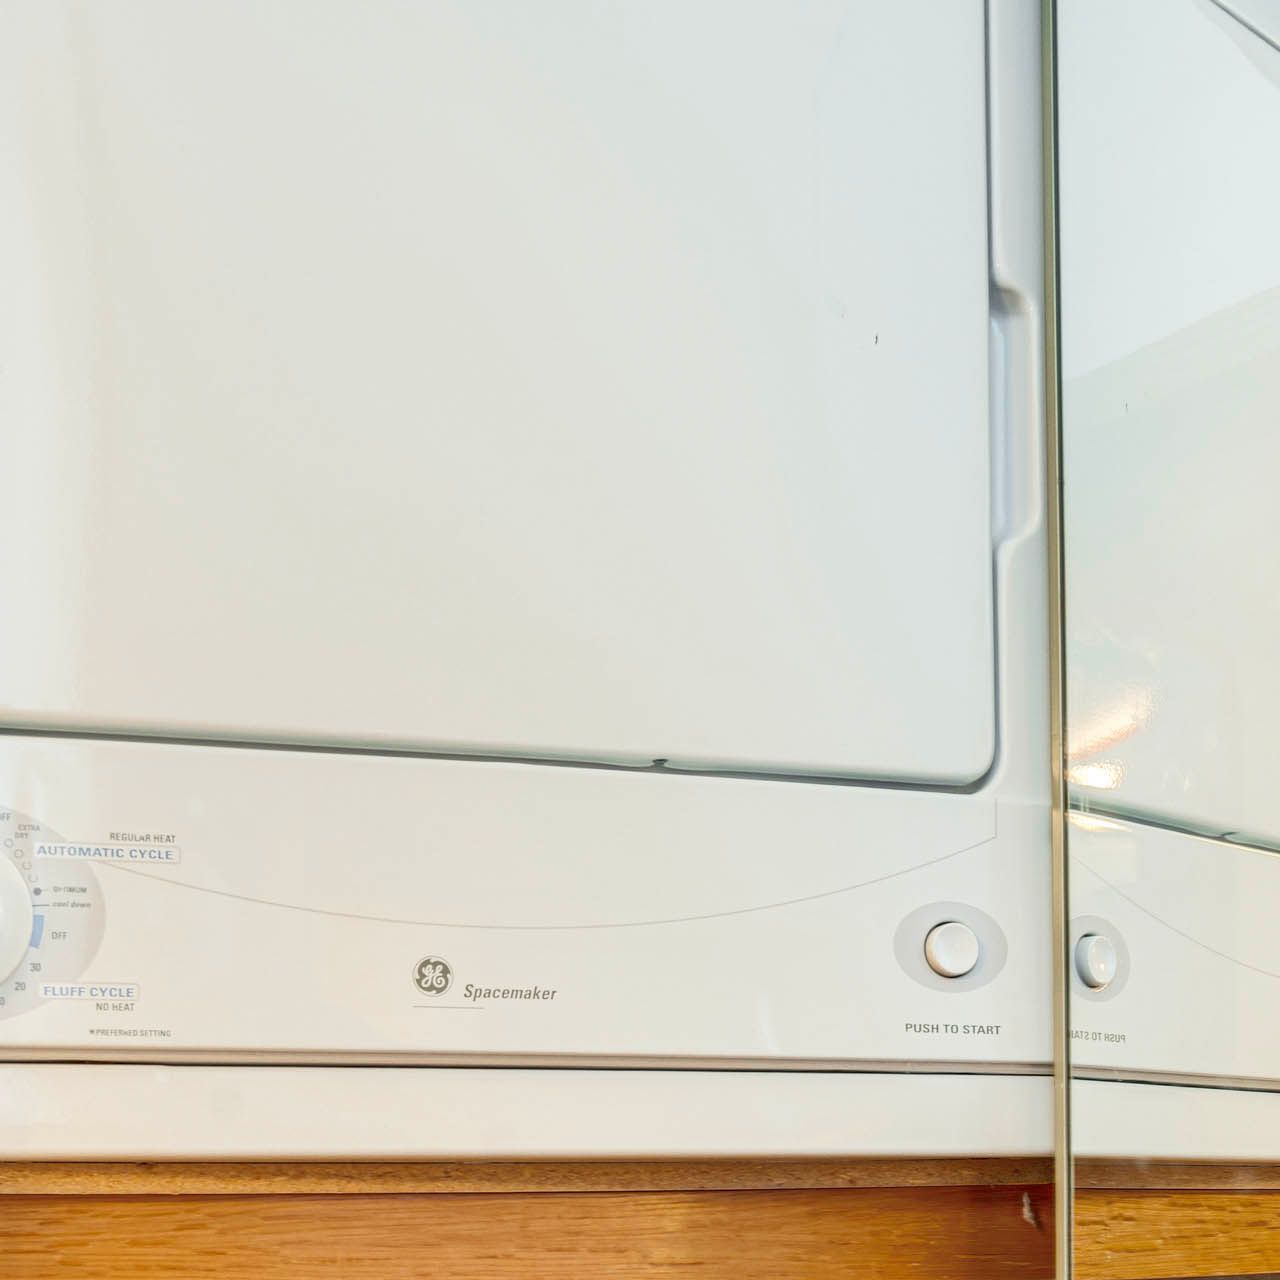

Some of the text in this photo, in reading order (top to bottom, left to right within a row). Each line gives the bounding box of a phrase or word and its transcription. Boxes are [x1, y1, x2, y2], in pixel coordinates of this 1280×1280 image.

[110, 832, 176, 844] REGULAR HEAT
[37, 845, 174, 860] AUTOMATIC CYCLE
[51, 931, 67, 940] OFF
[29, 962, 41, 972] 30
[14, 982, 26, 991] 20
[44, 986, 134, 998] FLUFF CYCLE
[463, 983, 557, 1002] Spacemaker
[96, 1003, 135, 1012] NO HEAT
[905, 1023, 1001, 1035] PUSH TO START
